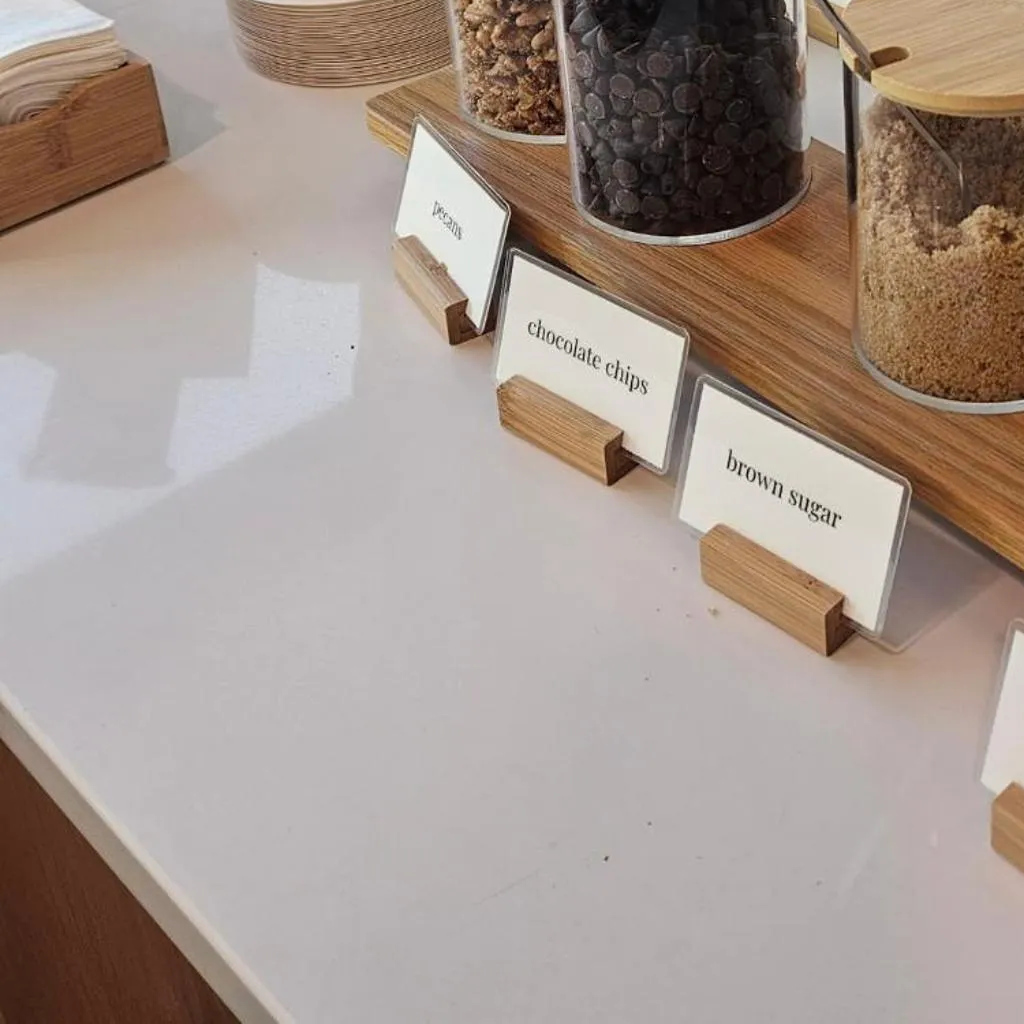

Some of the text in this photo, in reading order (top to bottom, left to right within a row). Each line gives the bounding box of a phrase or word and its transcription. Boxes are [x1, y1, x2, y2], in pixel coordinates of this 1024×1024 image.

[431, 200, 465, 241] pecans
[527, 318, 650, 395] chocolate chips
[726, 448, 842, 528] brown sugar
